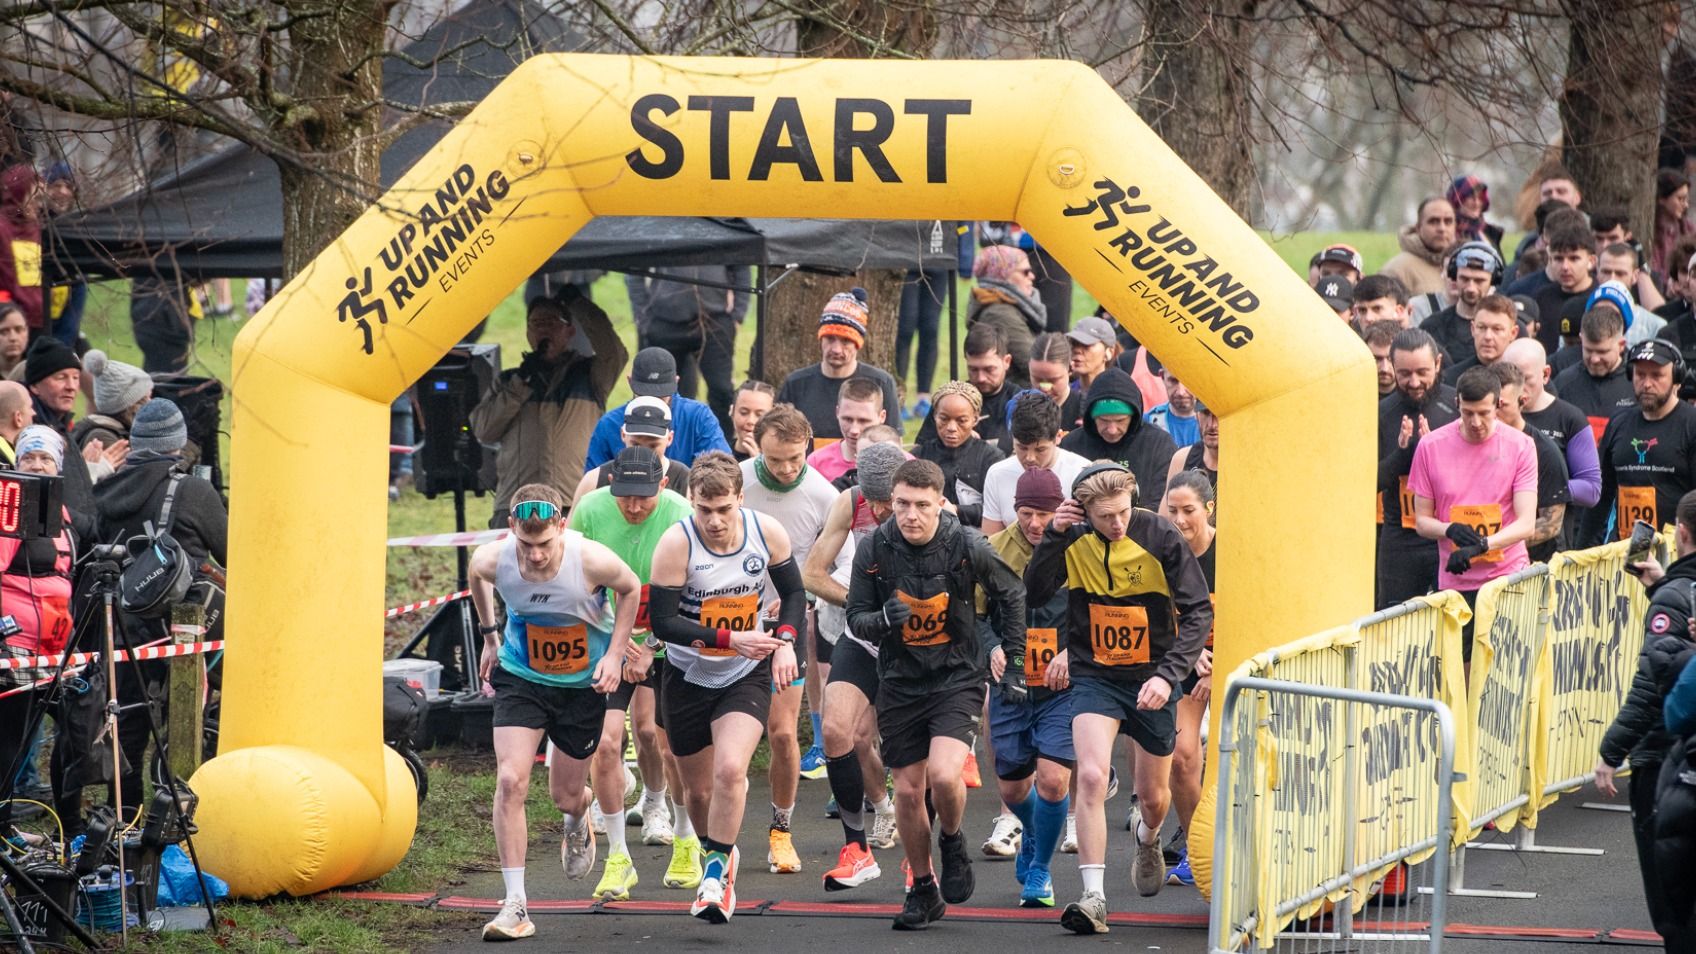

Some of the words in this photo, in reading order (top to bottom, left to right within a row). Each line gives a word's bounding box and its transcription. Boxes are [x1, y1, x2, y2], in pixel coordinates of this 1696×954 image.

[625, 93, 972, 184] START
[376, 223, 416, 272] UP
[418, 163, 475, 236] AND
[384, 169, 511, 310] RUNNING
[439, 228, 495, 293] EVENTS
[1147, 215, 1198, 257] UP
[1183, 253, 1260, 314] AND
[1108, 227, 1254, 349] RUNNING
[1128, 279, 1195, 335] EVENTS
[0, 481, 20, 532] 0
[134, 567, 165, 592] HUUB
[688, 584, 750, 598] Edinburgh
[706, 613, 755, 632] 1094
[908, 609, 949, 632] 069
[1095, 624, 1147, 650] 1087
[531, 638, 586, 662] 1095
